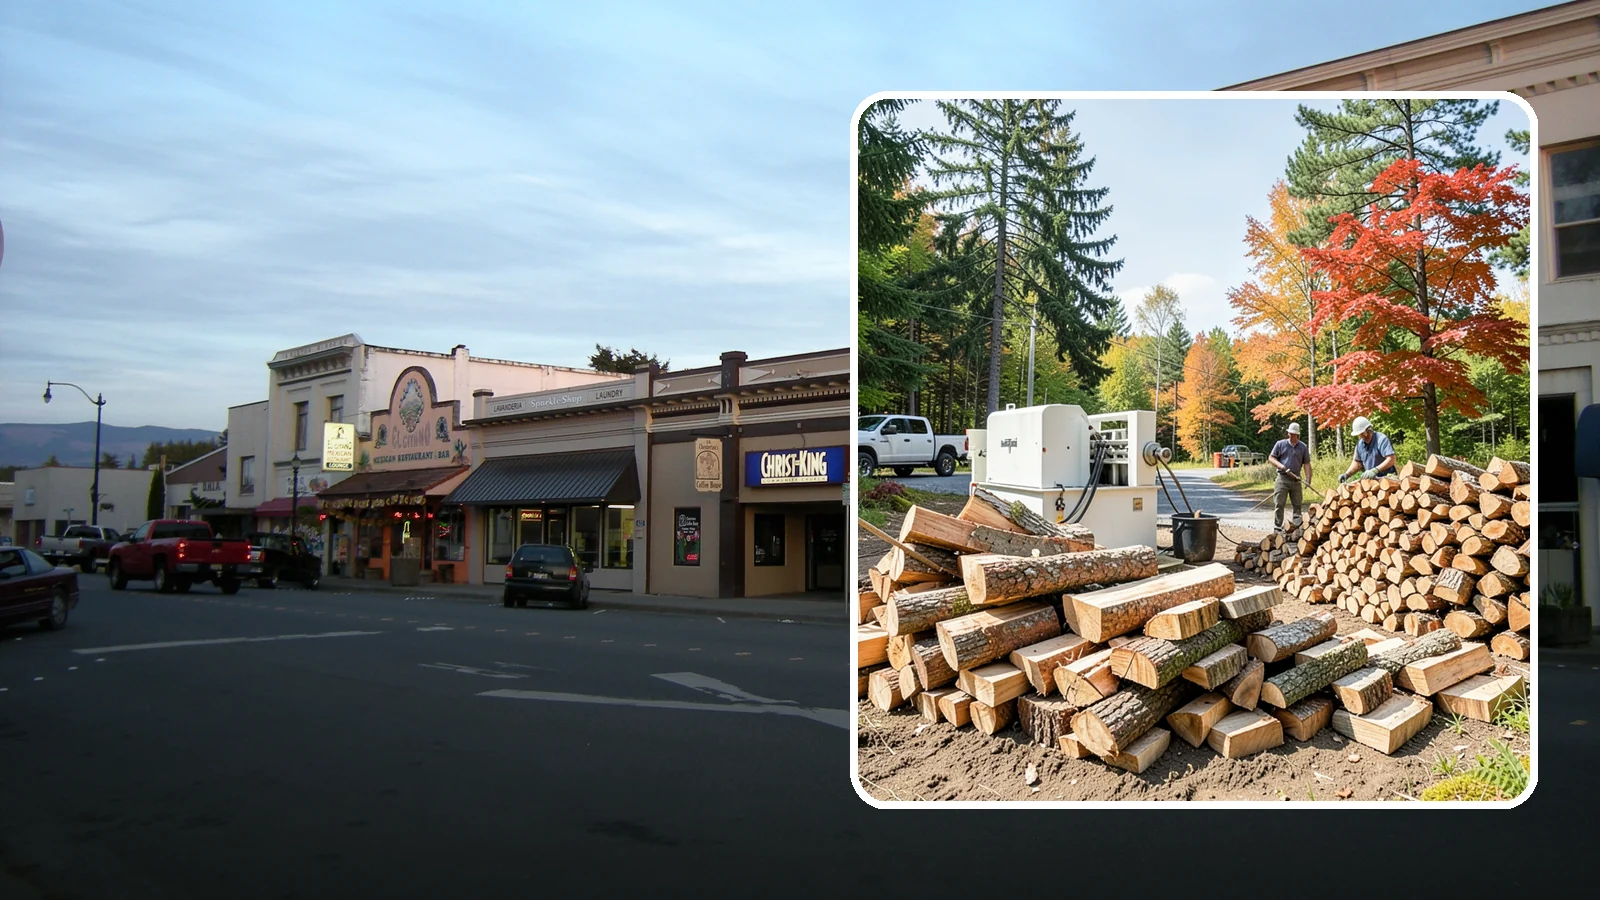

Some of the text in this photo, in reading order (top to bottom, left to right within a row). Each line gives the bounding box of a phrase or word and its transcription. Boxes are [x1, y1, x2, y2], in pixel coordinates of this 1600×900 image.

[494, 402, 522, 412] LAVANDERIA
[596, 389, 623, 399] LAUNDRY
[373, 449, 450, 464] MEXICAN RESTAURANT BAR
[761, 450, 827, 478] CHRIST KING
